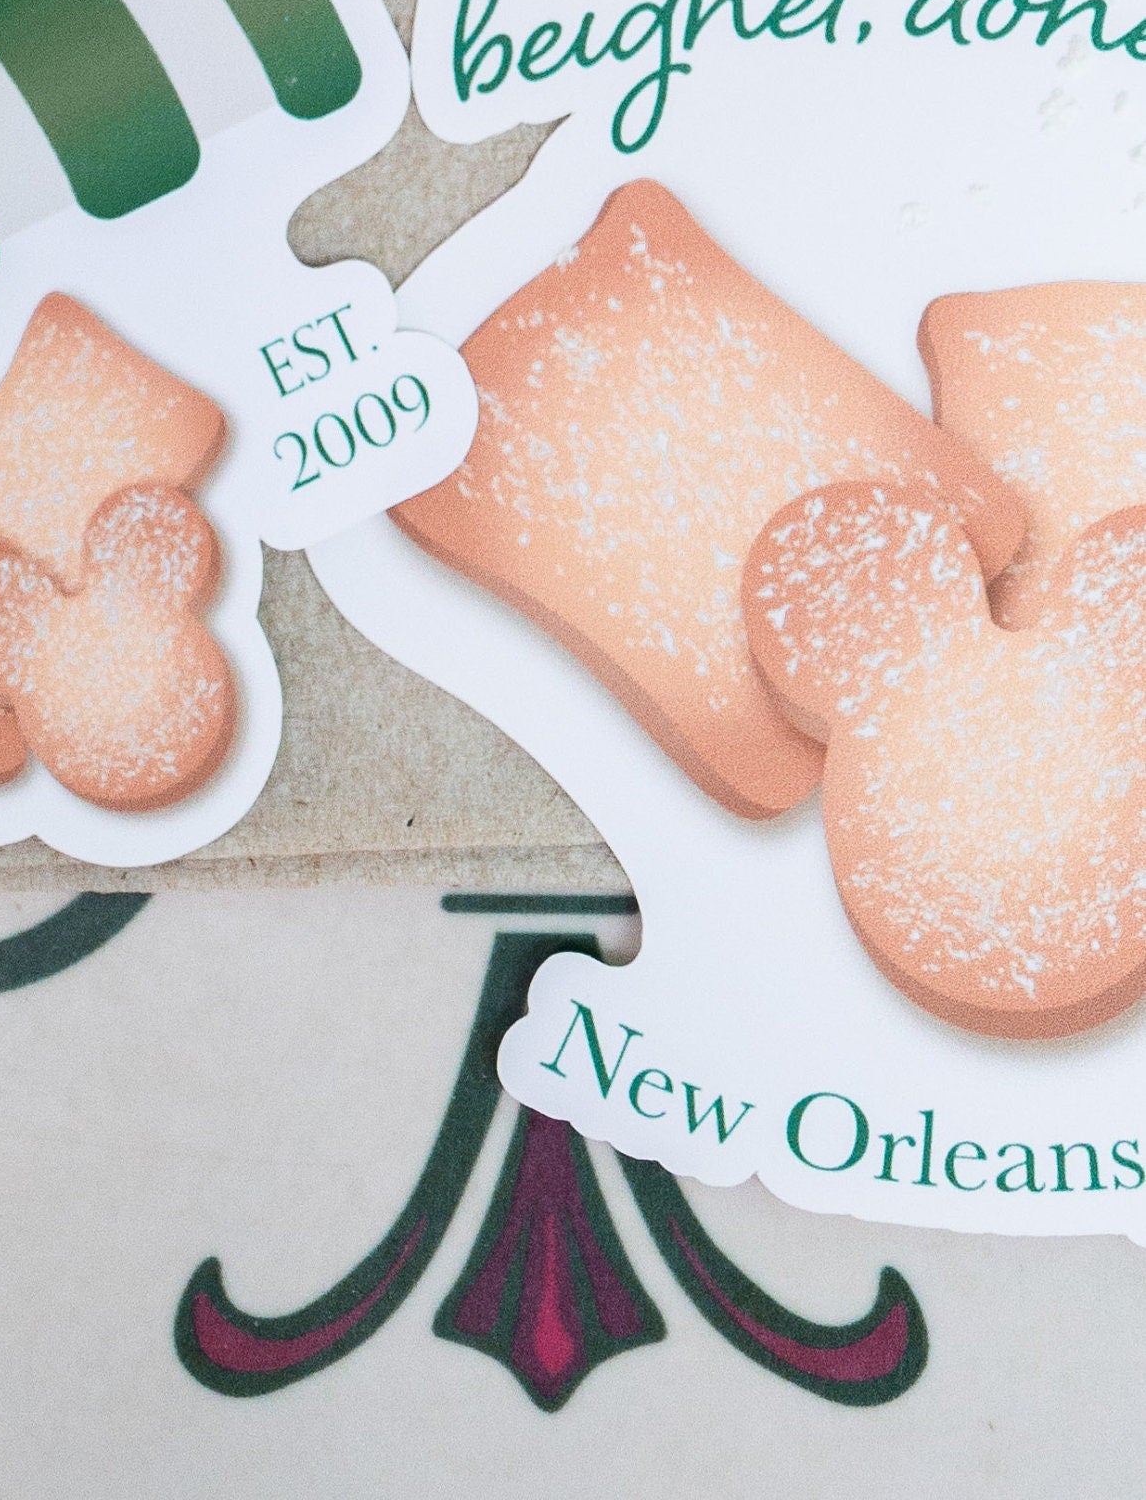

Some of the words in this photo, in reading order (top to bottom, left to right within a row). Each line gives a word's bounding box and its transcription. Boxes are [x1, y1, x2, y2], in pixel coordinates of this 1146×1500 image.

[258, 303, 378, 397] EST.
[273, 374, 430, 492] 2009
[539, 999, 756, 1145] New
[785, 1091, 1146, 1193] Orleans
